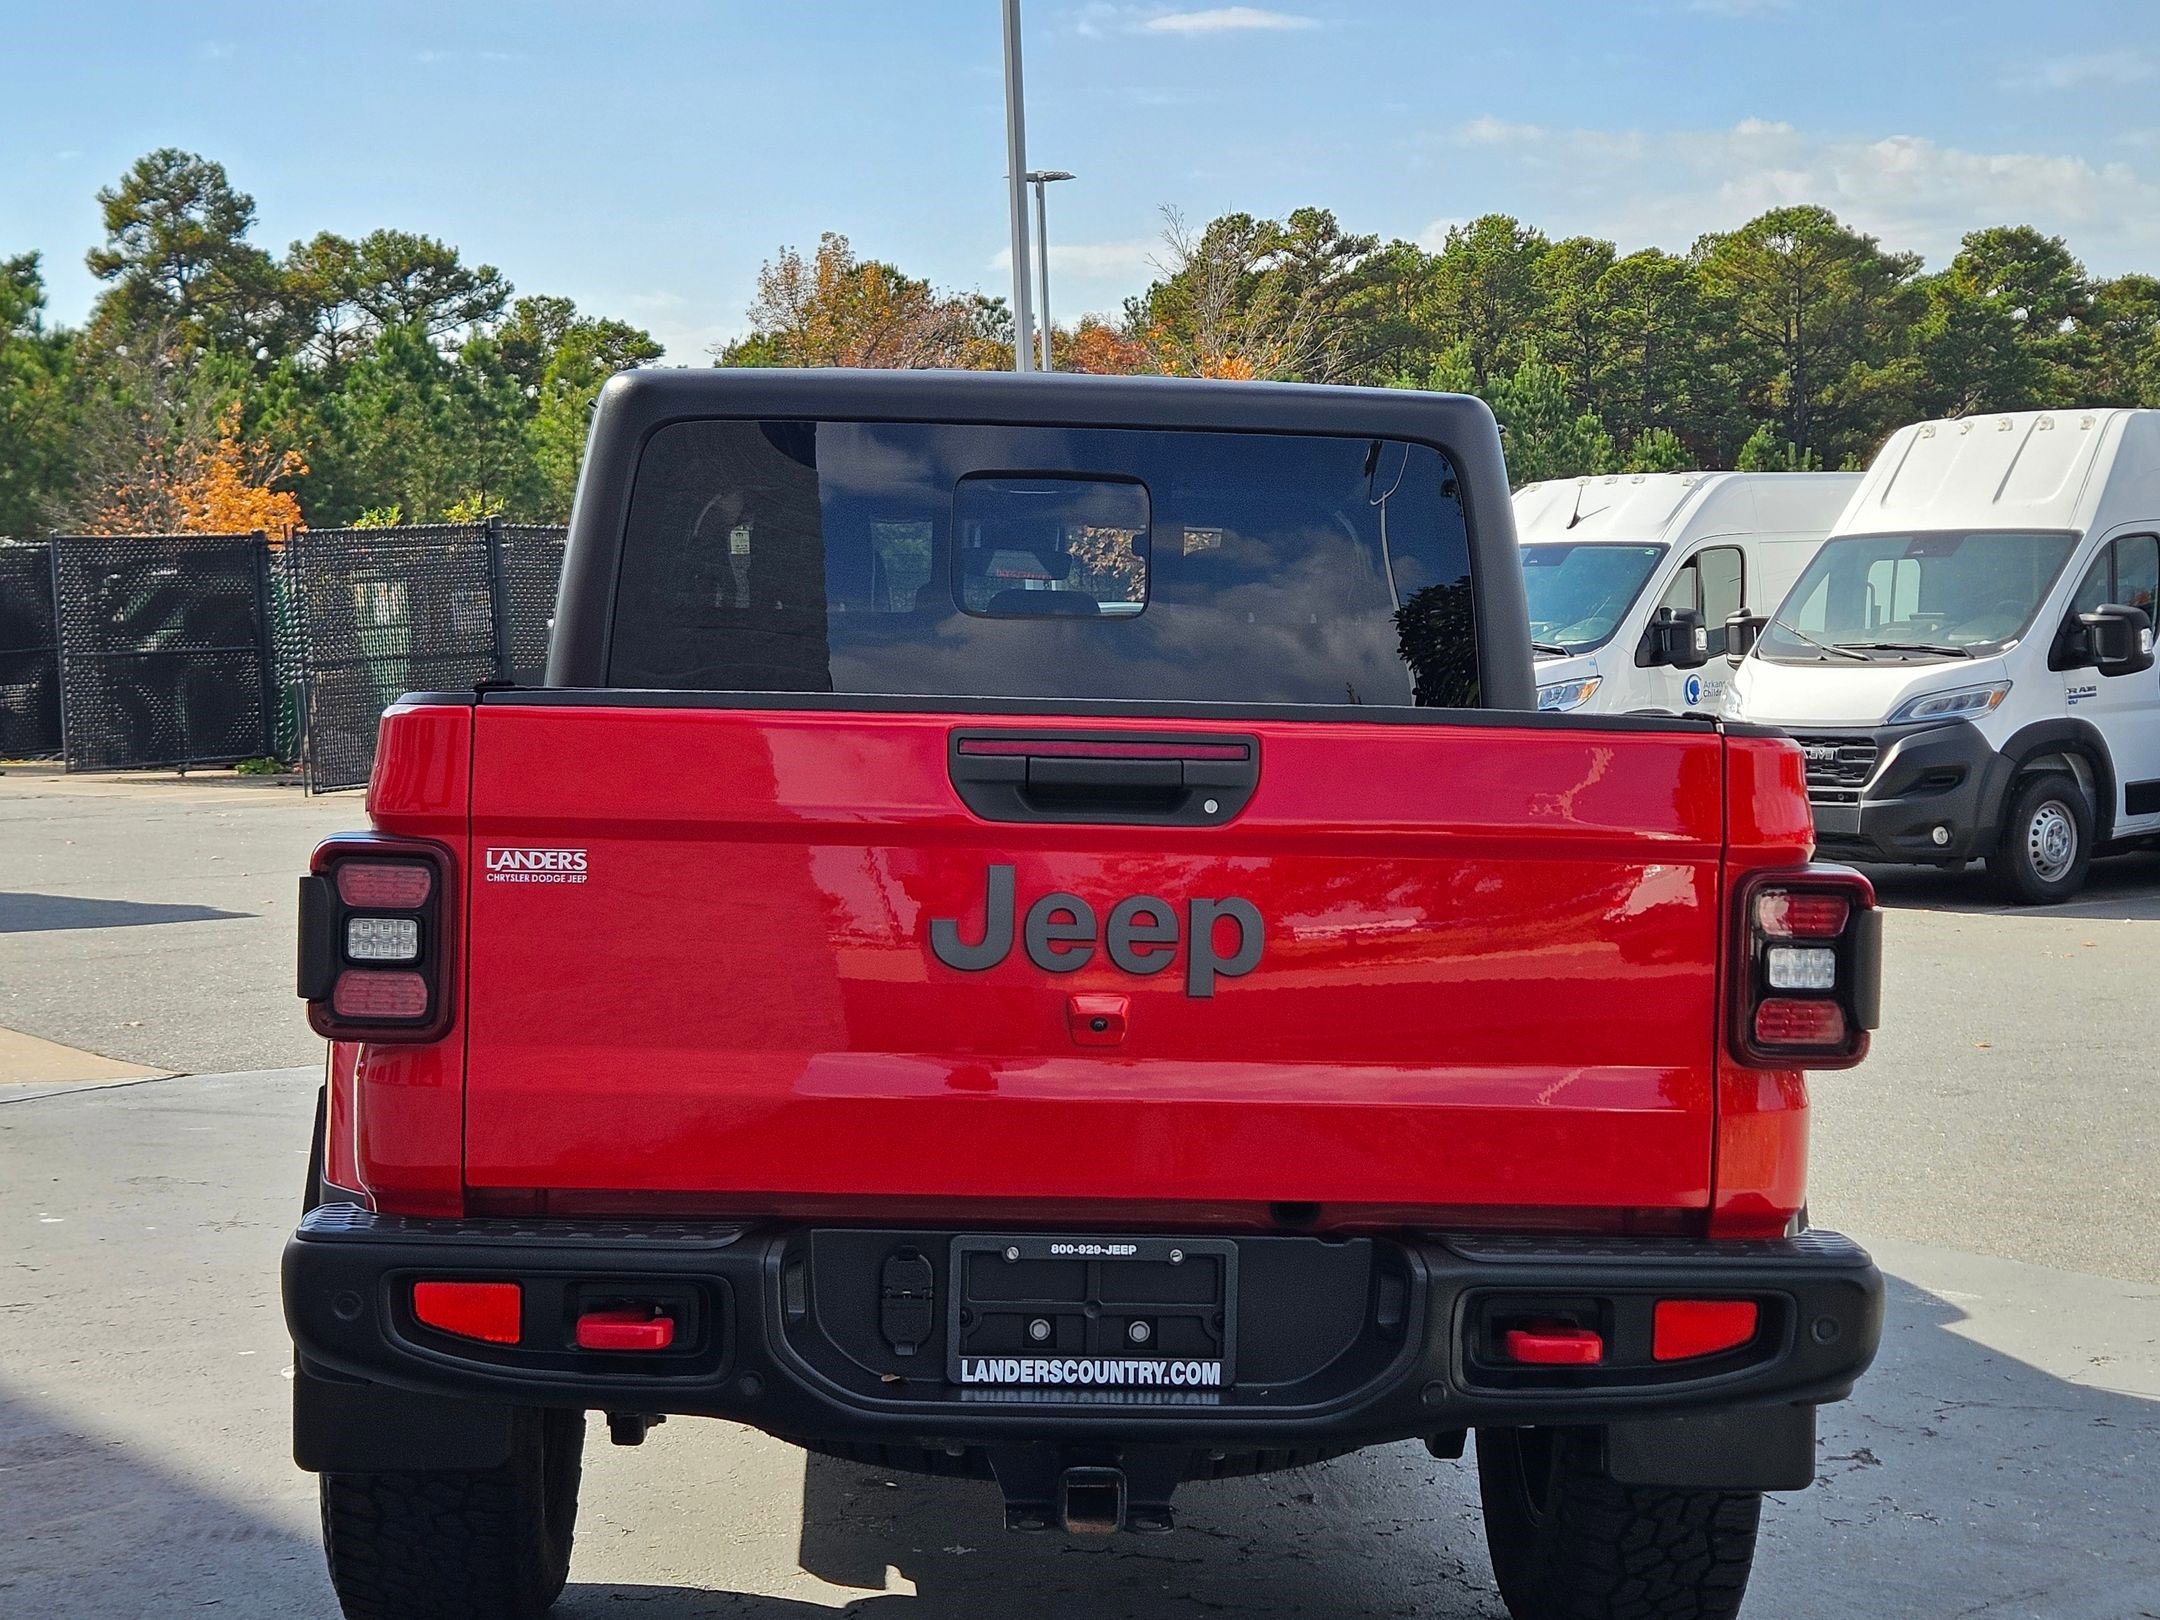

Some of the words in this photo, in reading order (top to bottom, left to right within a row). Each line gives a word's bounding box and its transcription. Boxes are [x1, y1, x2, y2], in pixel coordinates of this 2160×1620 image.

[486, 850, 588, 871] LANDERS
[486, 873, 530, 883] CHRYSLER
[531, 874, 566, 883] DODGE
[567, 874, 588, 884] JEEP
[929, 864, 1265, 998] Jeep
[1050, 1243, 1138, 1256] 800-929-JEEP
[961, 1359, 1222, 1385] LANDERSCOUNTRY.COM
